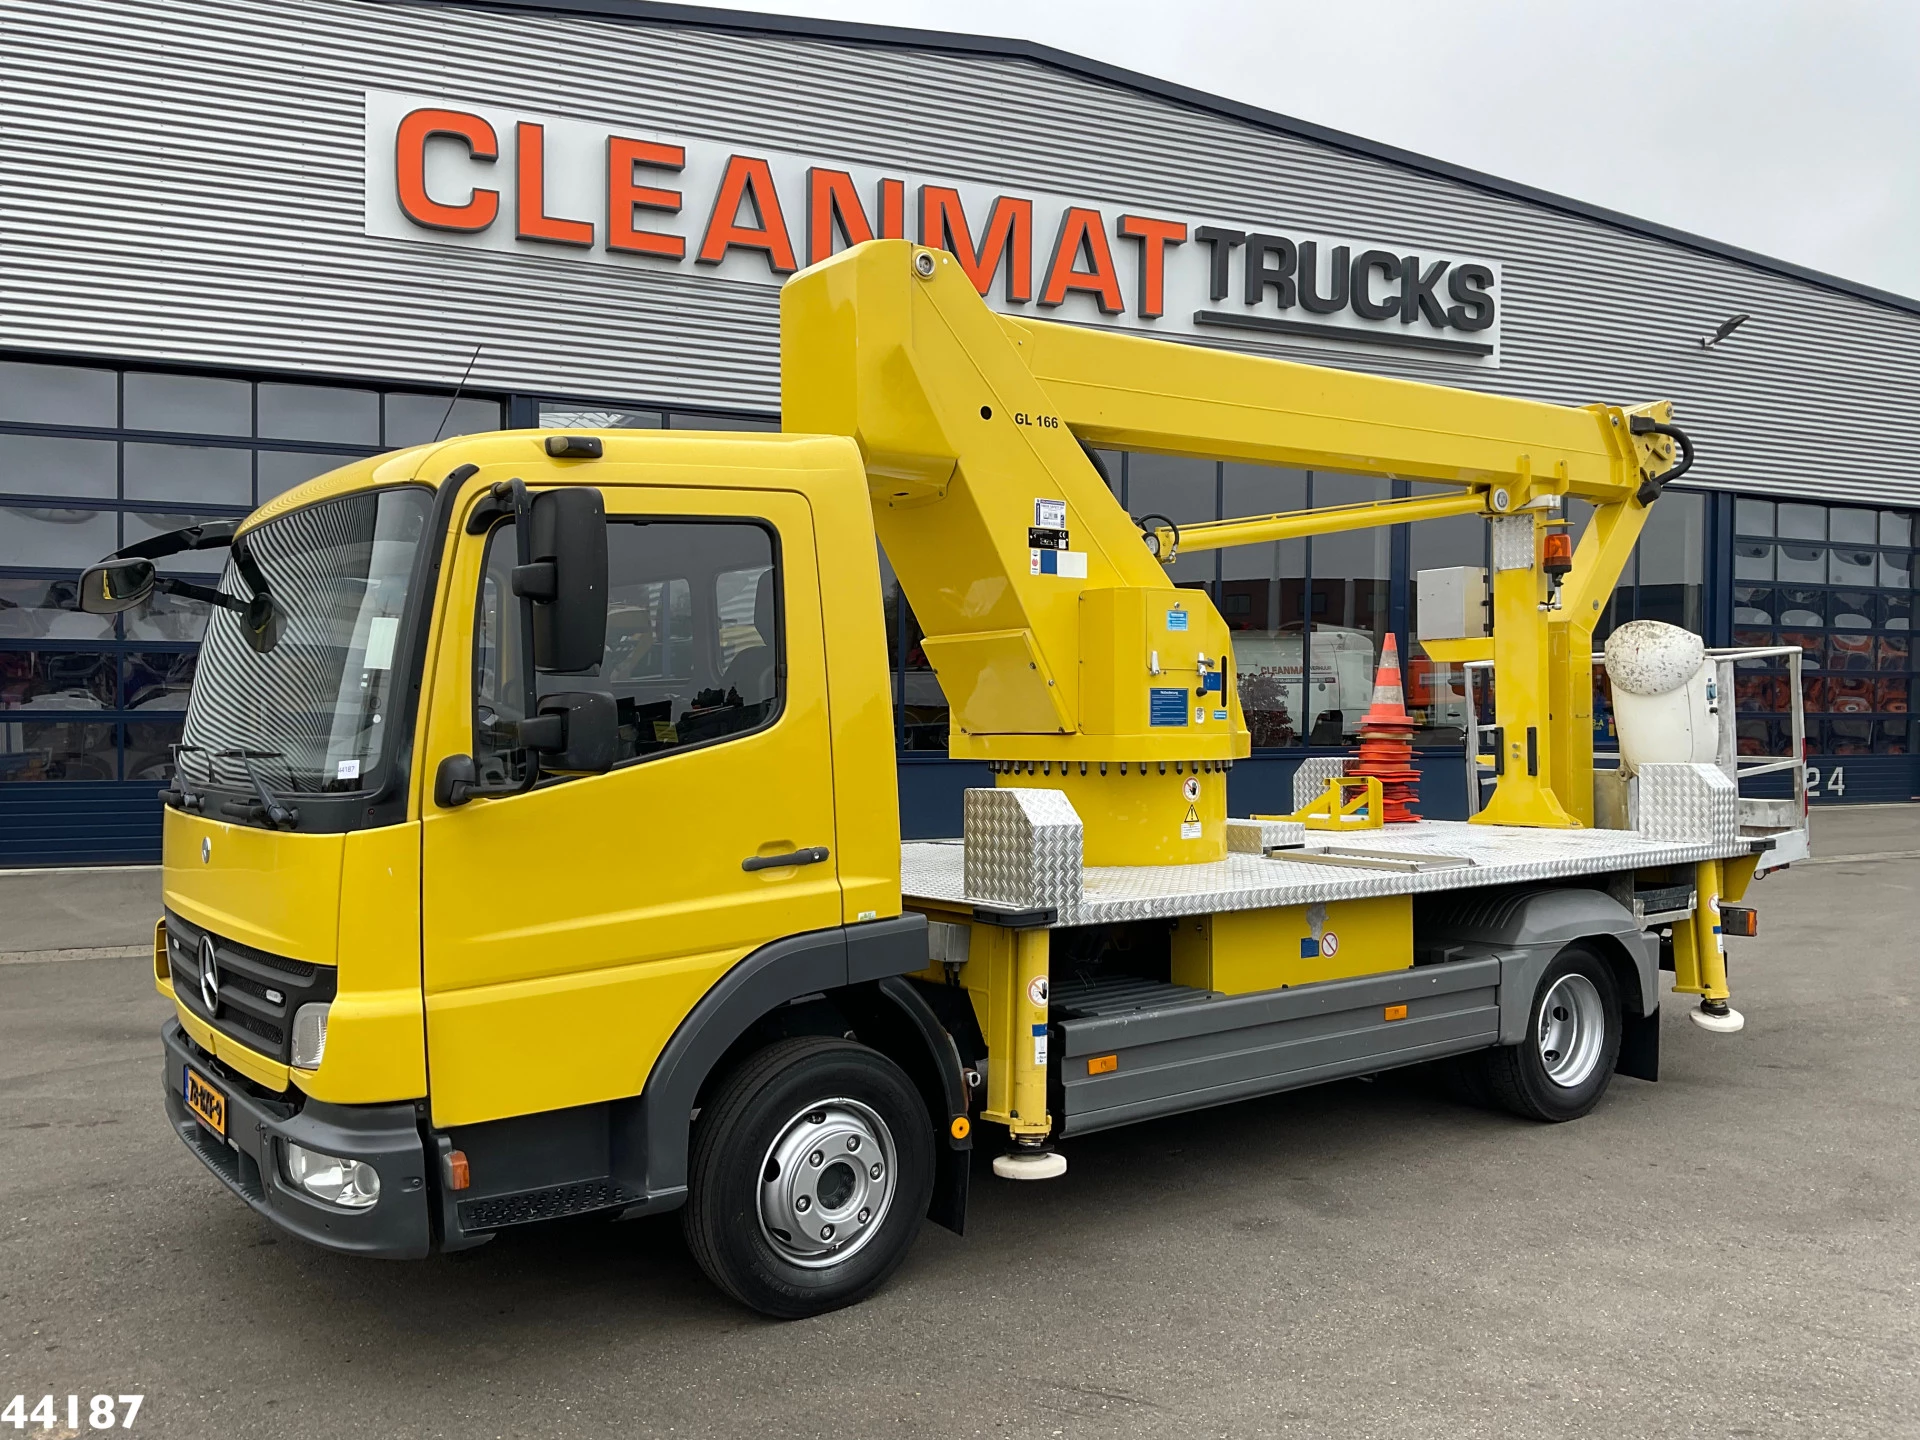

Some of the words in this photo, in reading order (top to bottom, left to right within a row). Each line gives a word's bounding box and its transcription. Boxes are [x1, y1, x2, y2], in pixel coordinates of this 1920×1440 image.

[394, 107, 1188, 319] CLEANMAT
[1195, 225, 1496, 332] TRUCKS
[1014, 412, 1033, 426] GL
[1036, 415, 1059, 429] 166
[1260, 665, 1304, 675] CLEANMA
[1806, 766, 1846, 797] 24
